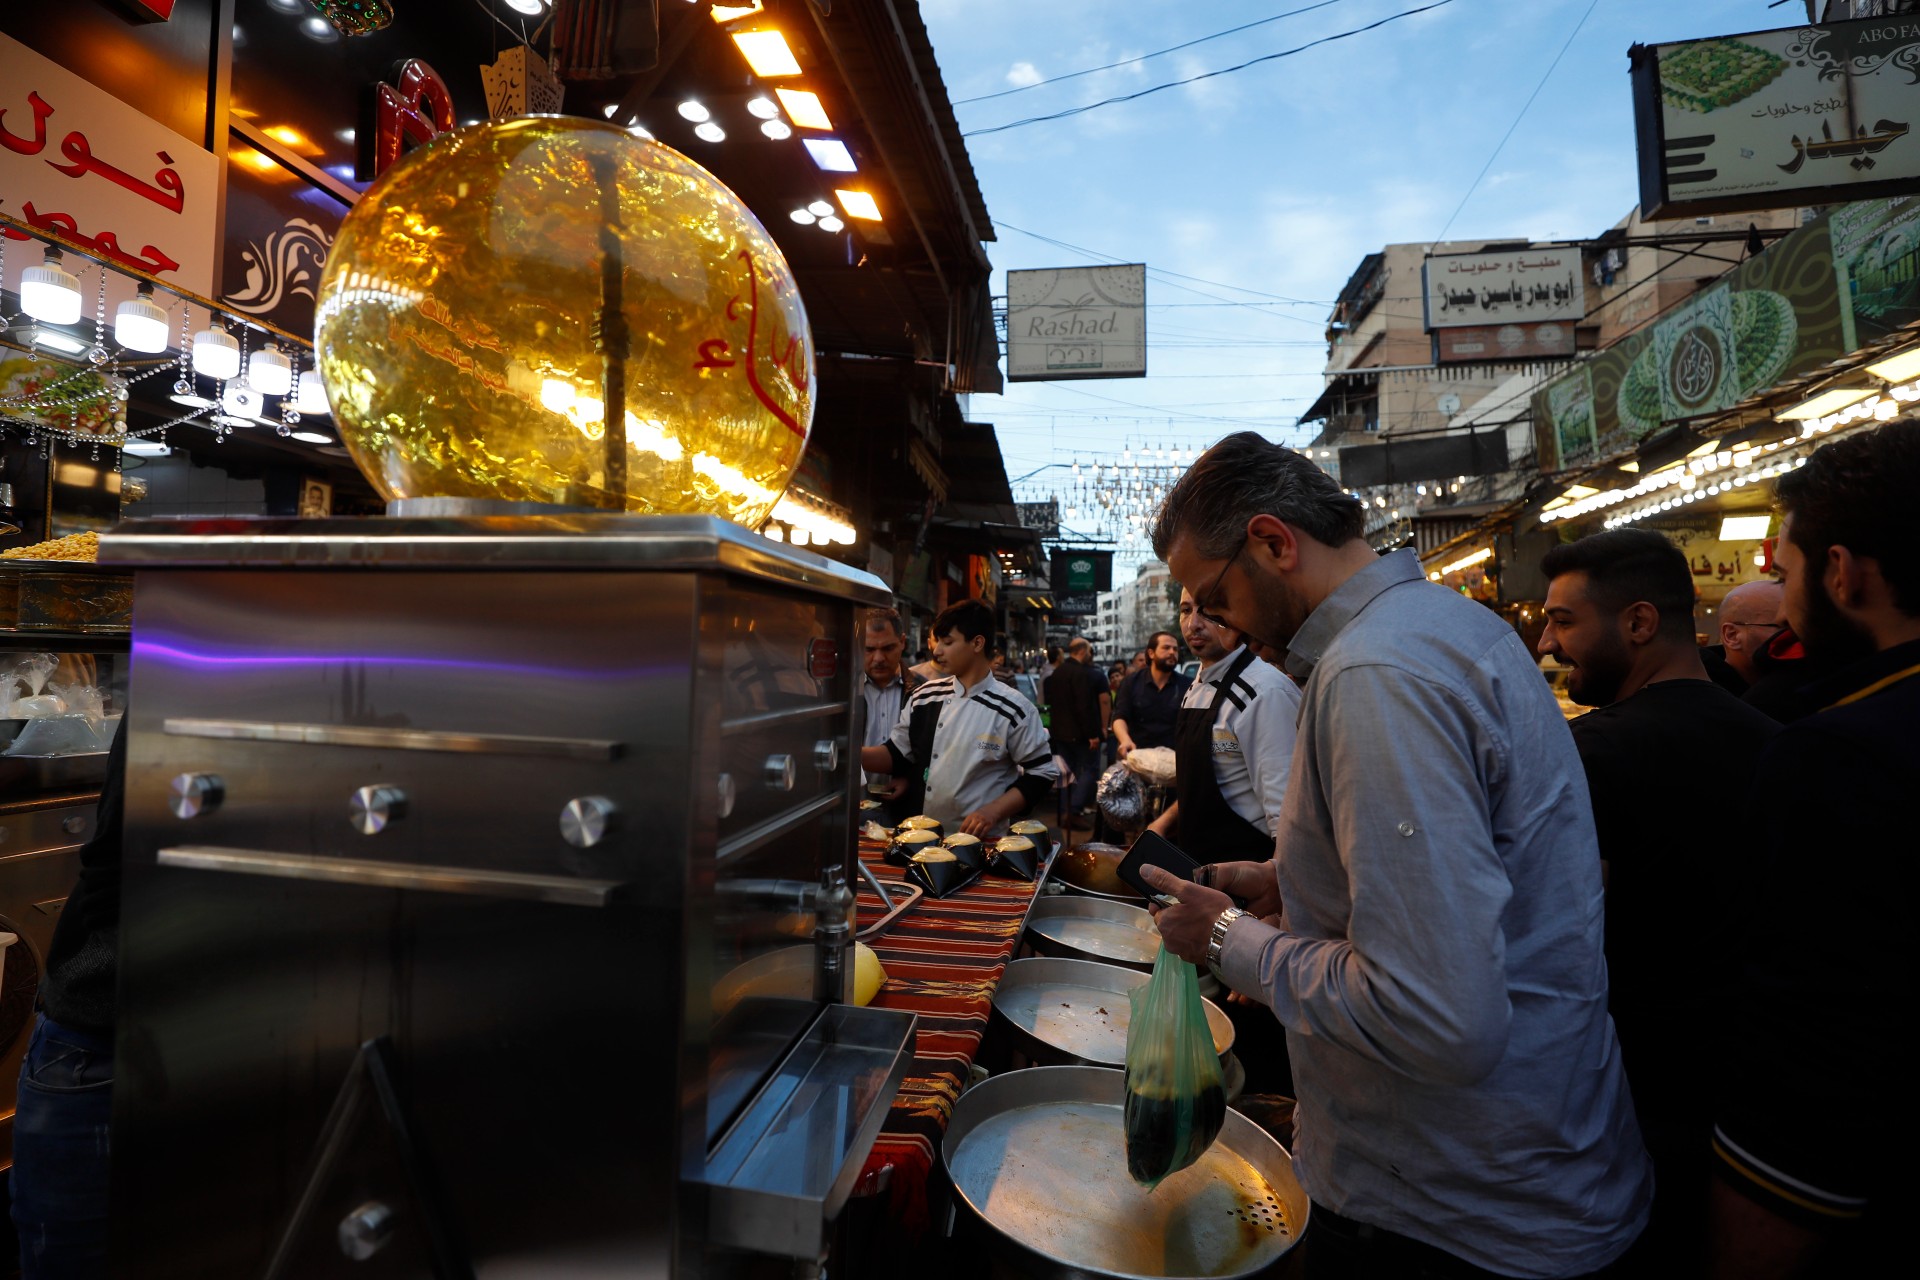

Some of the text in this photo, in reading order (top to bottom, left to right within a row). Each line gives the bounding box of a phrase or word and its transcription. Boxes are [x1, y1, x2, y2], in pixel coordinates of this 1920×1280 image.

[1858, 27, 1897, 44] ABO
[0, 90, 185, 214] فول
[1776, 118, 1910, 174] حيدر
[1838, 221, 1892, 256] Damascene
[1840, 223, 1860, 239] Abu
[1448, 260, 1501, 275] حلويات
[1517, 257, 1560, 273] مطبخ
[1440, 271, 1575, 312] أبو بدر ياسين حيدر
[1028, 311, 1116, 337] Rashad
